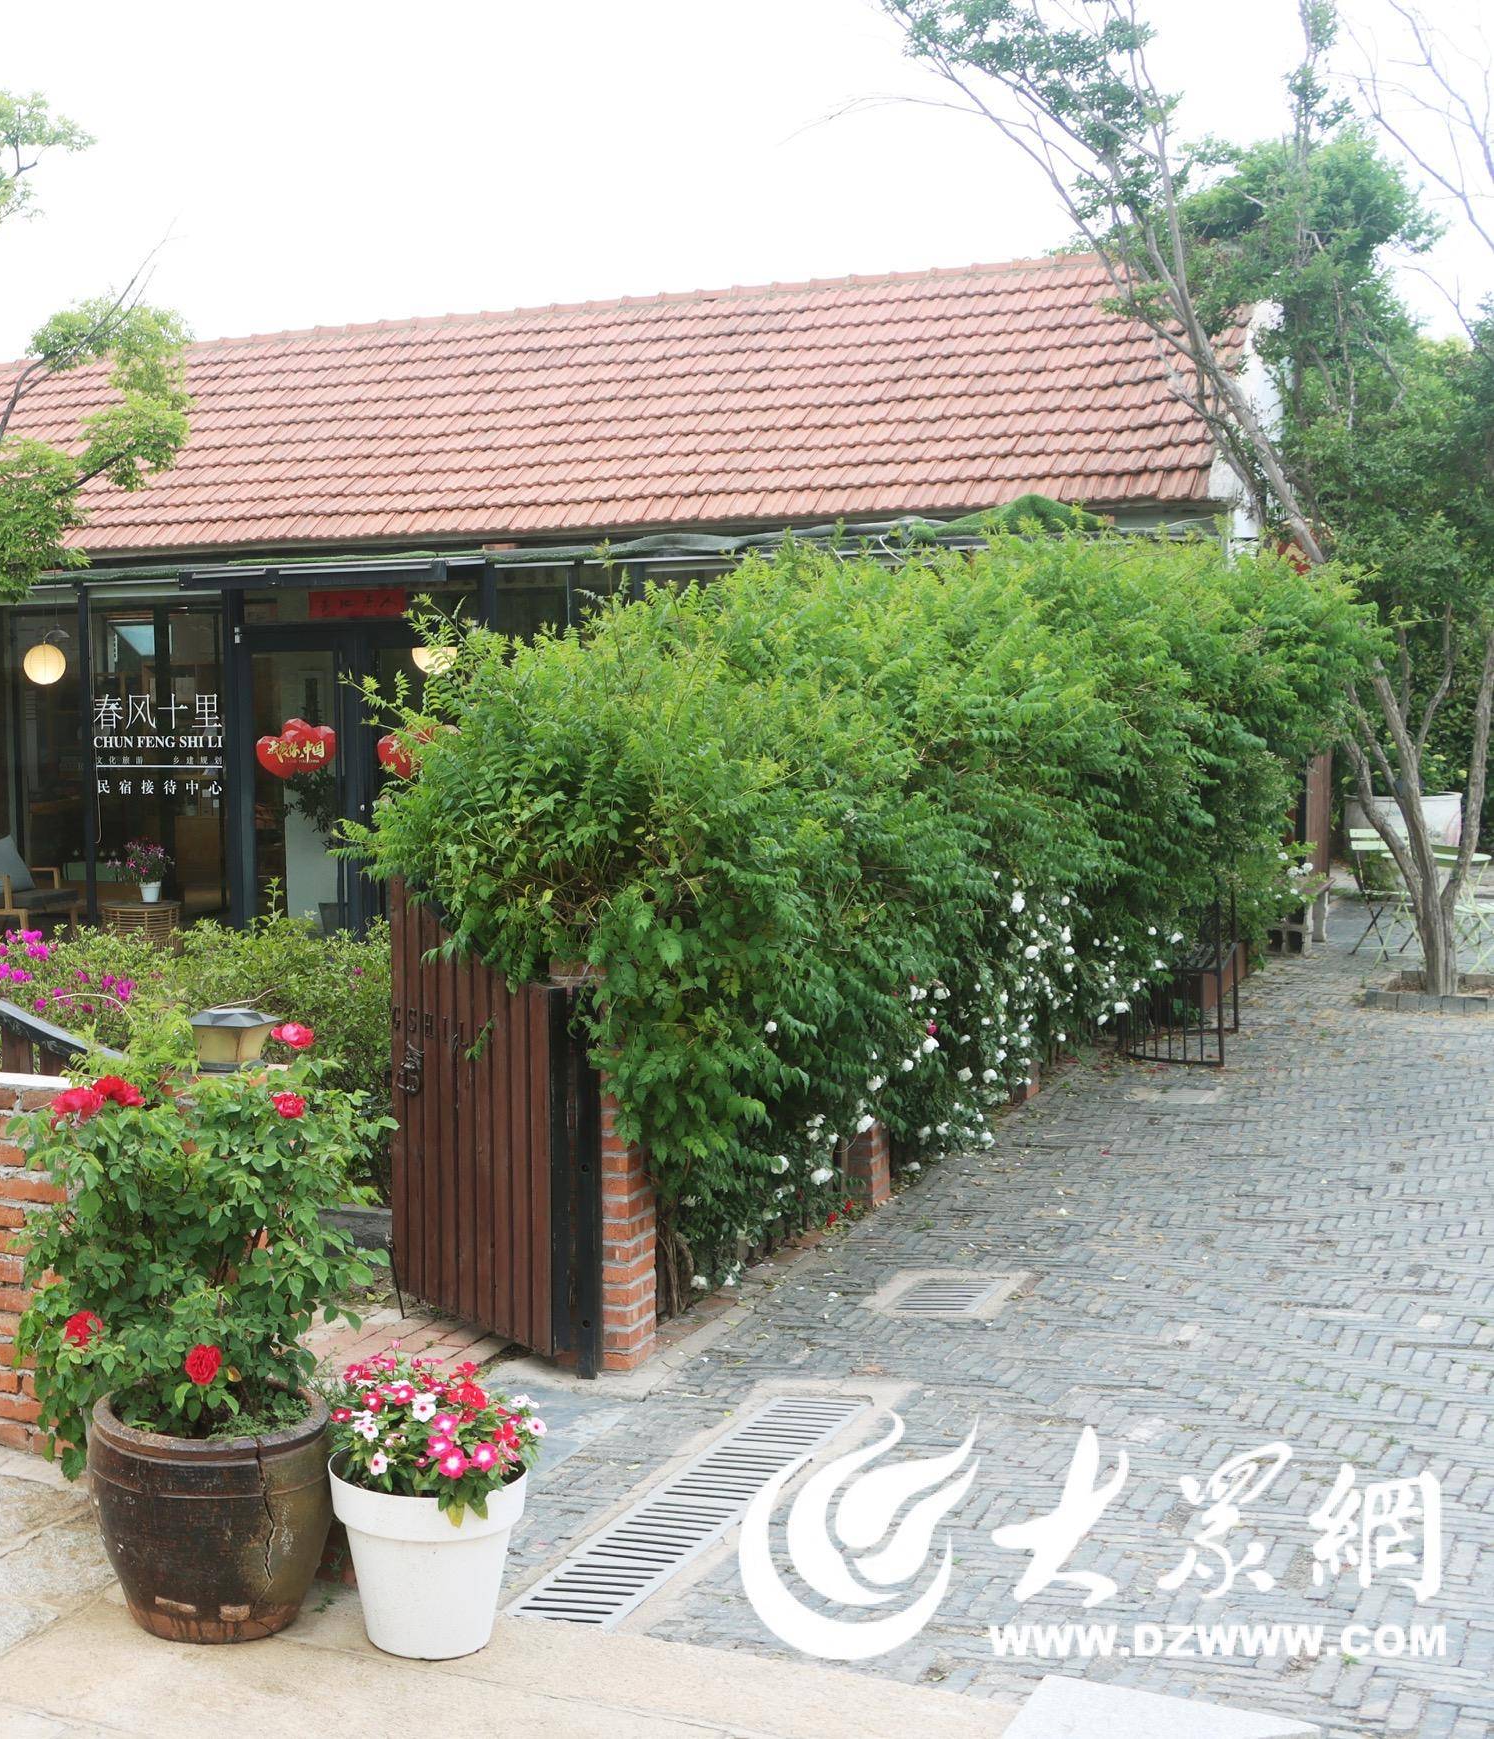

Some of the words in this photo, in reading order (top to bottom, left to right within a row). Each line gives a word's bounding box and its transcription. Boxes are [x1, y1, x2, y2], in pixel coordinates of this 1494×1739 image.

[93, 693, 223, 730] 春风十里
[93, 735, 134, 749] CHUN
[137, 735, 175, 749] FENG
[179, 735, 204, 749] SHI
[207, 735, 223, 748] LI
[173, 755, 223, 765] 乡建规划
[97, 779, 223, 797] 民宿接待中心
